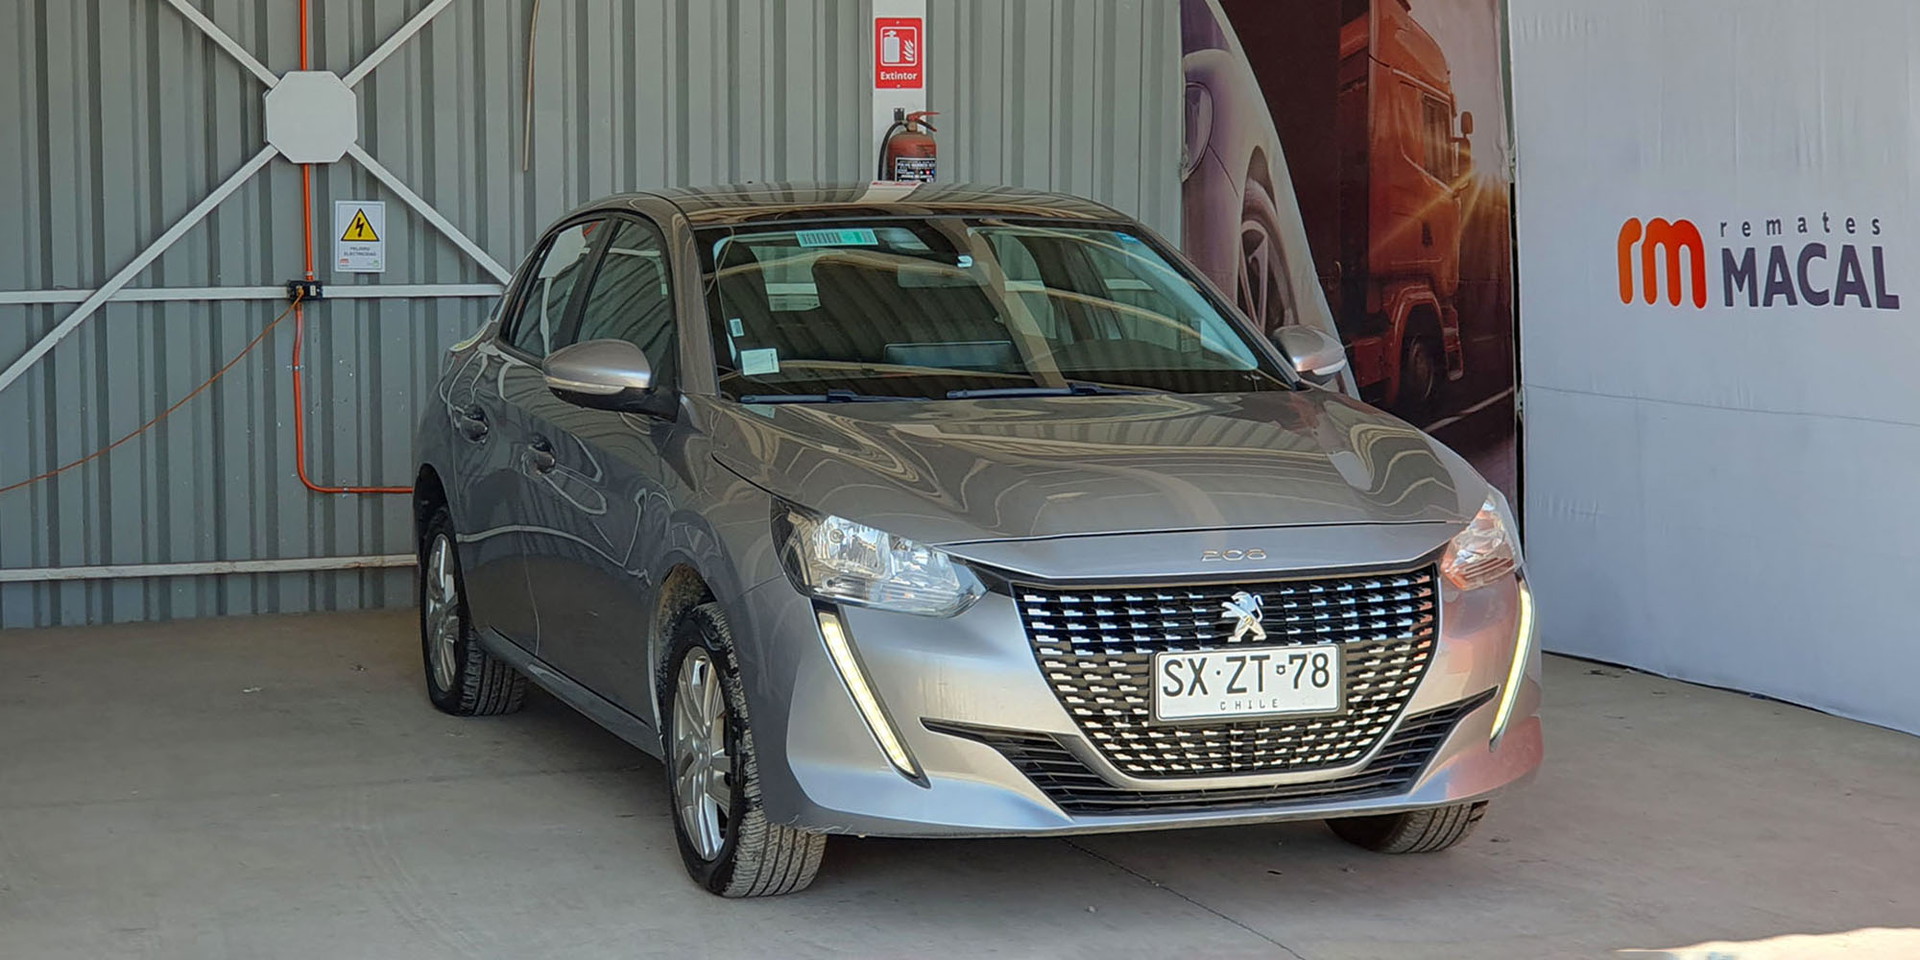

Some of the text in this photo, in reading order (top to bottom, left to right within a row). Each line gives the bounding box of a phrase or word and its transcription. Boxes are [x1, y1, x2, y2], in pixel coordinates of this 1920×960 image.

[880, 71, 917, 80] Extintor
[1720, 211, 1882, 237] remates
[1722, 242, 1900, 309] MACAL
[1201, 548, 1267, 562] 208
[1220, 699, 1279, 711] CHILE
